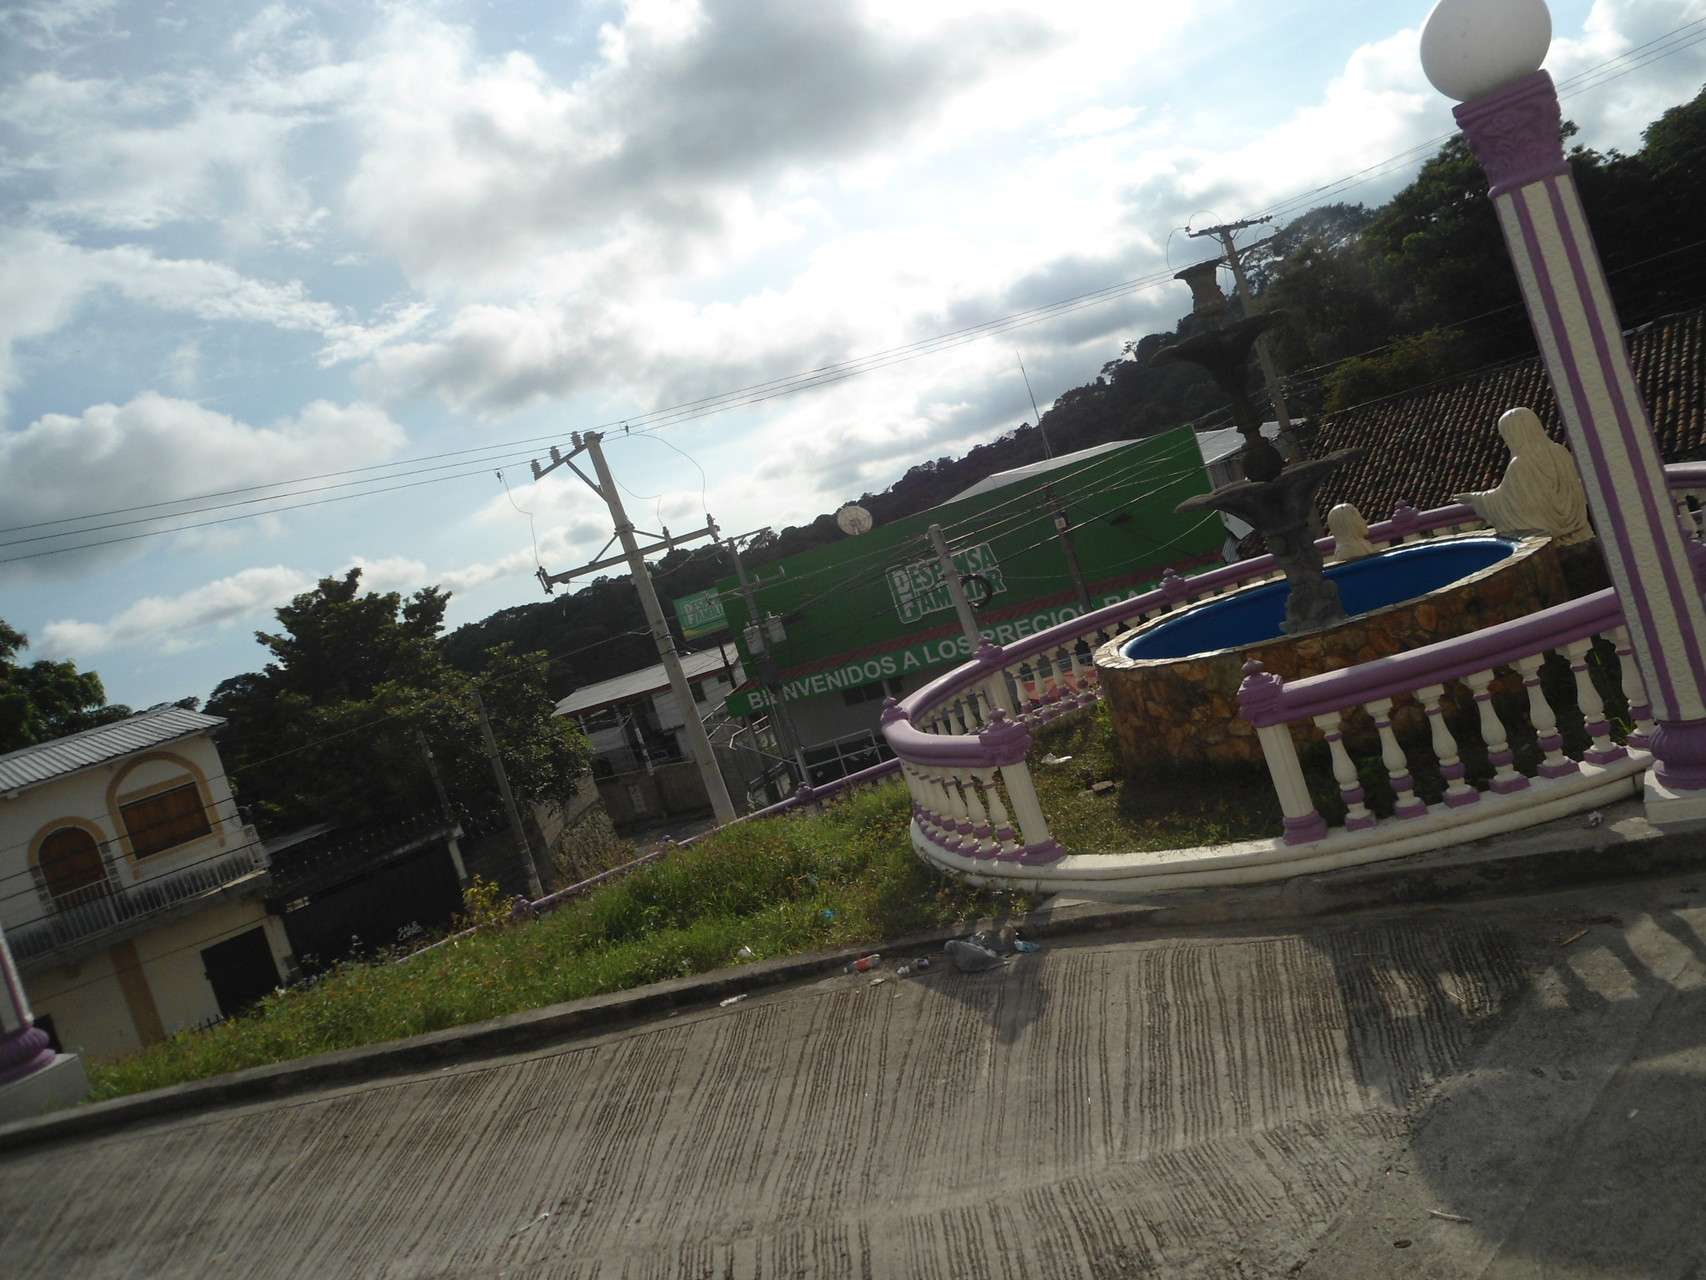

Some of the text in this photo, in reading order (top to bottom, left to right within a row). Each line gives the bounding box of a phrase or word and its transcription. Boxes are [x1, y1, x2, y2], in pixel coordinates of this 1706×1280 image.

[891, 545, 998, 594] DESPNSA
[899, 569, 1007, 619] FAMIAR
[903, 651, 921, 671] A
[922, 636, 974, 665] LOS
[980, 603, 1094, 646] PRECIO
